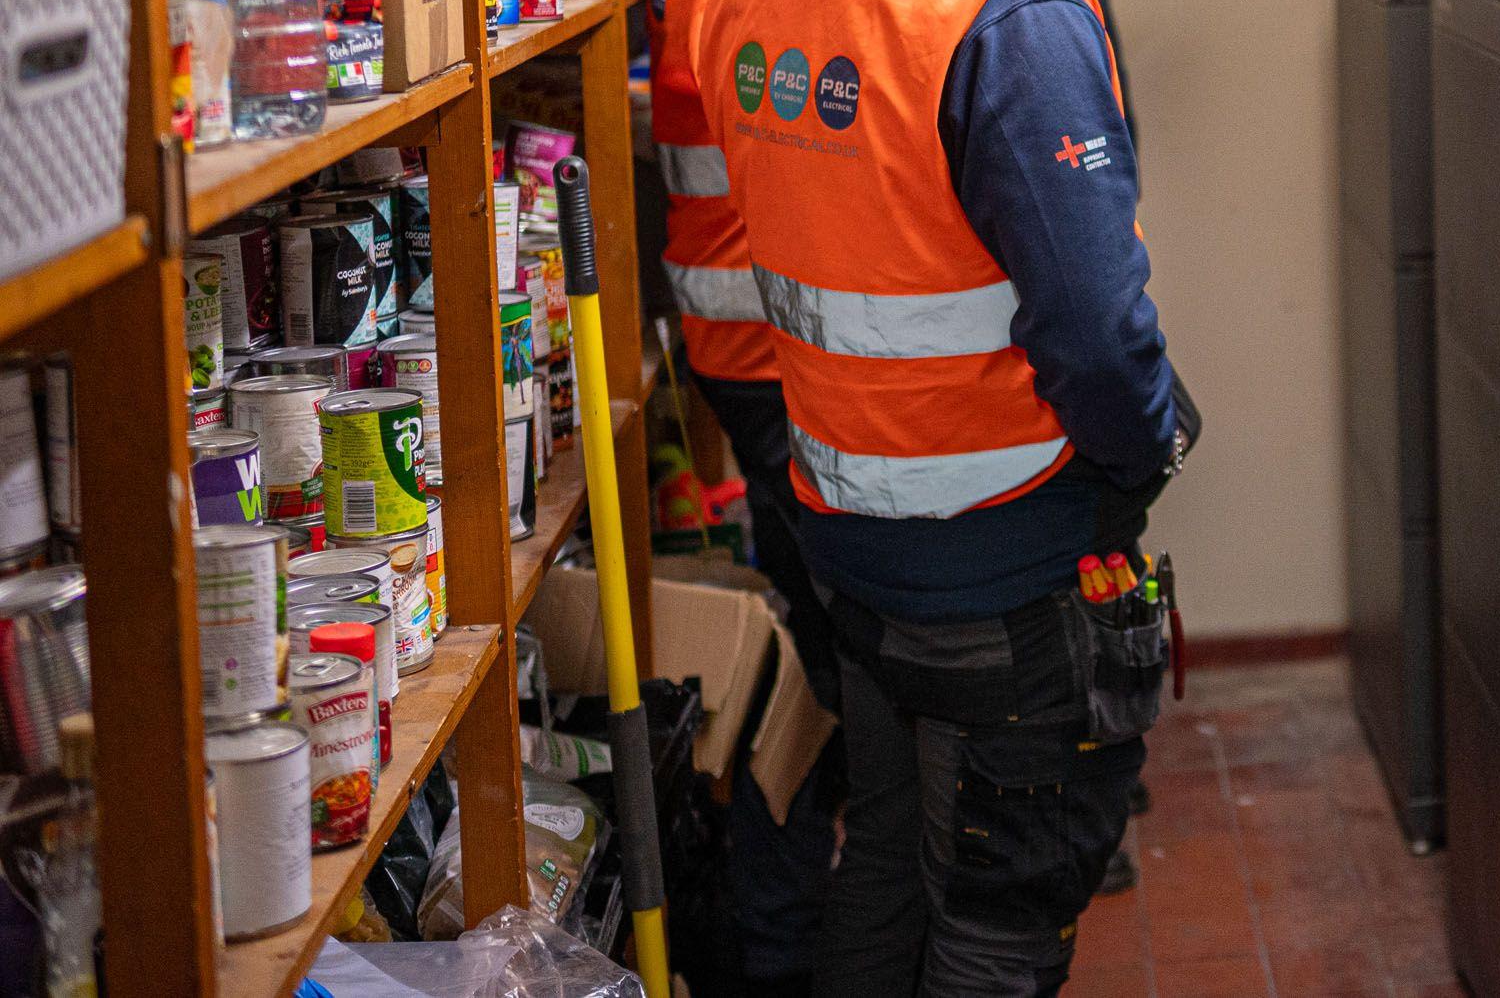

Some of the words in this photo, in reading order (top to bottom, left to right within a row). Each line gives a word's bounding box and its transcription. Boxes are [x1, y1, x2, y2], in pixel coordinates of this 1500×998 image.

[738, 63, 765, 83] P&C
[774, 70, 807, 91] P&C
[820, 78, 858, 100] P&C
[822, 100, 853, 114] ELECTRICAL
[337, 265, 367, 280] COCONUT
[347, 275, 363, 286] MILK
[195, 410, 226, 427] axters
[312, 697, 367, 723] Baxters
